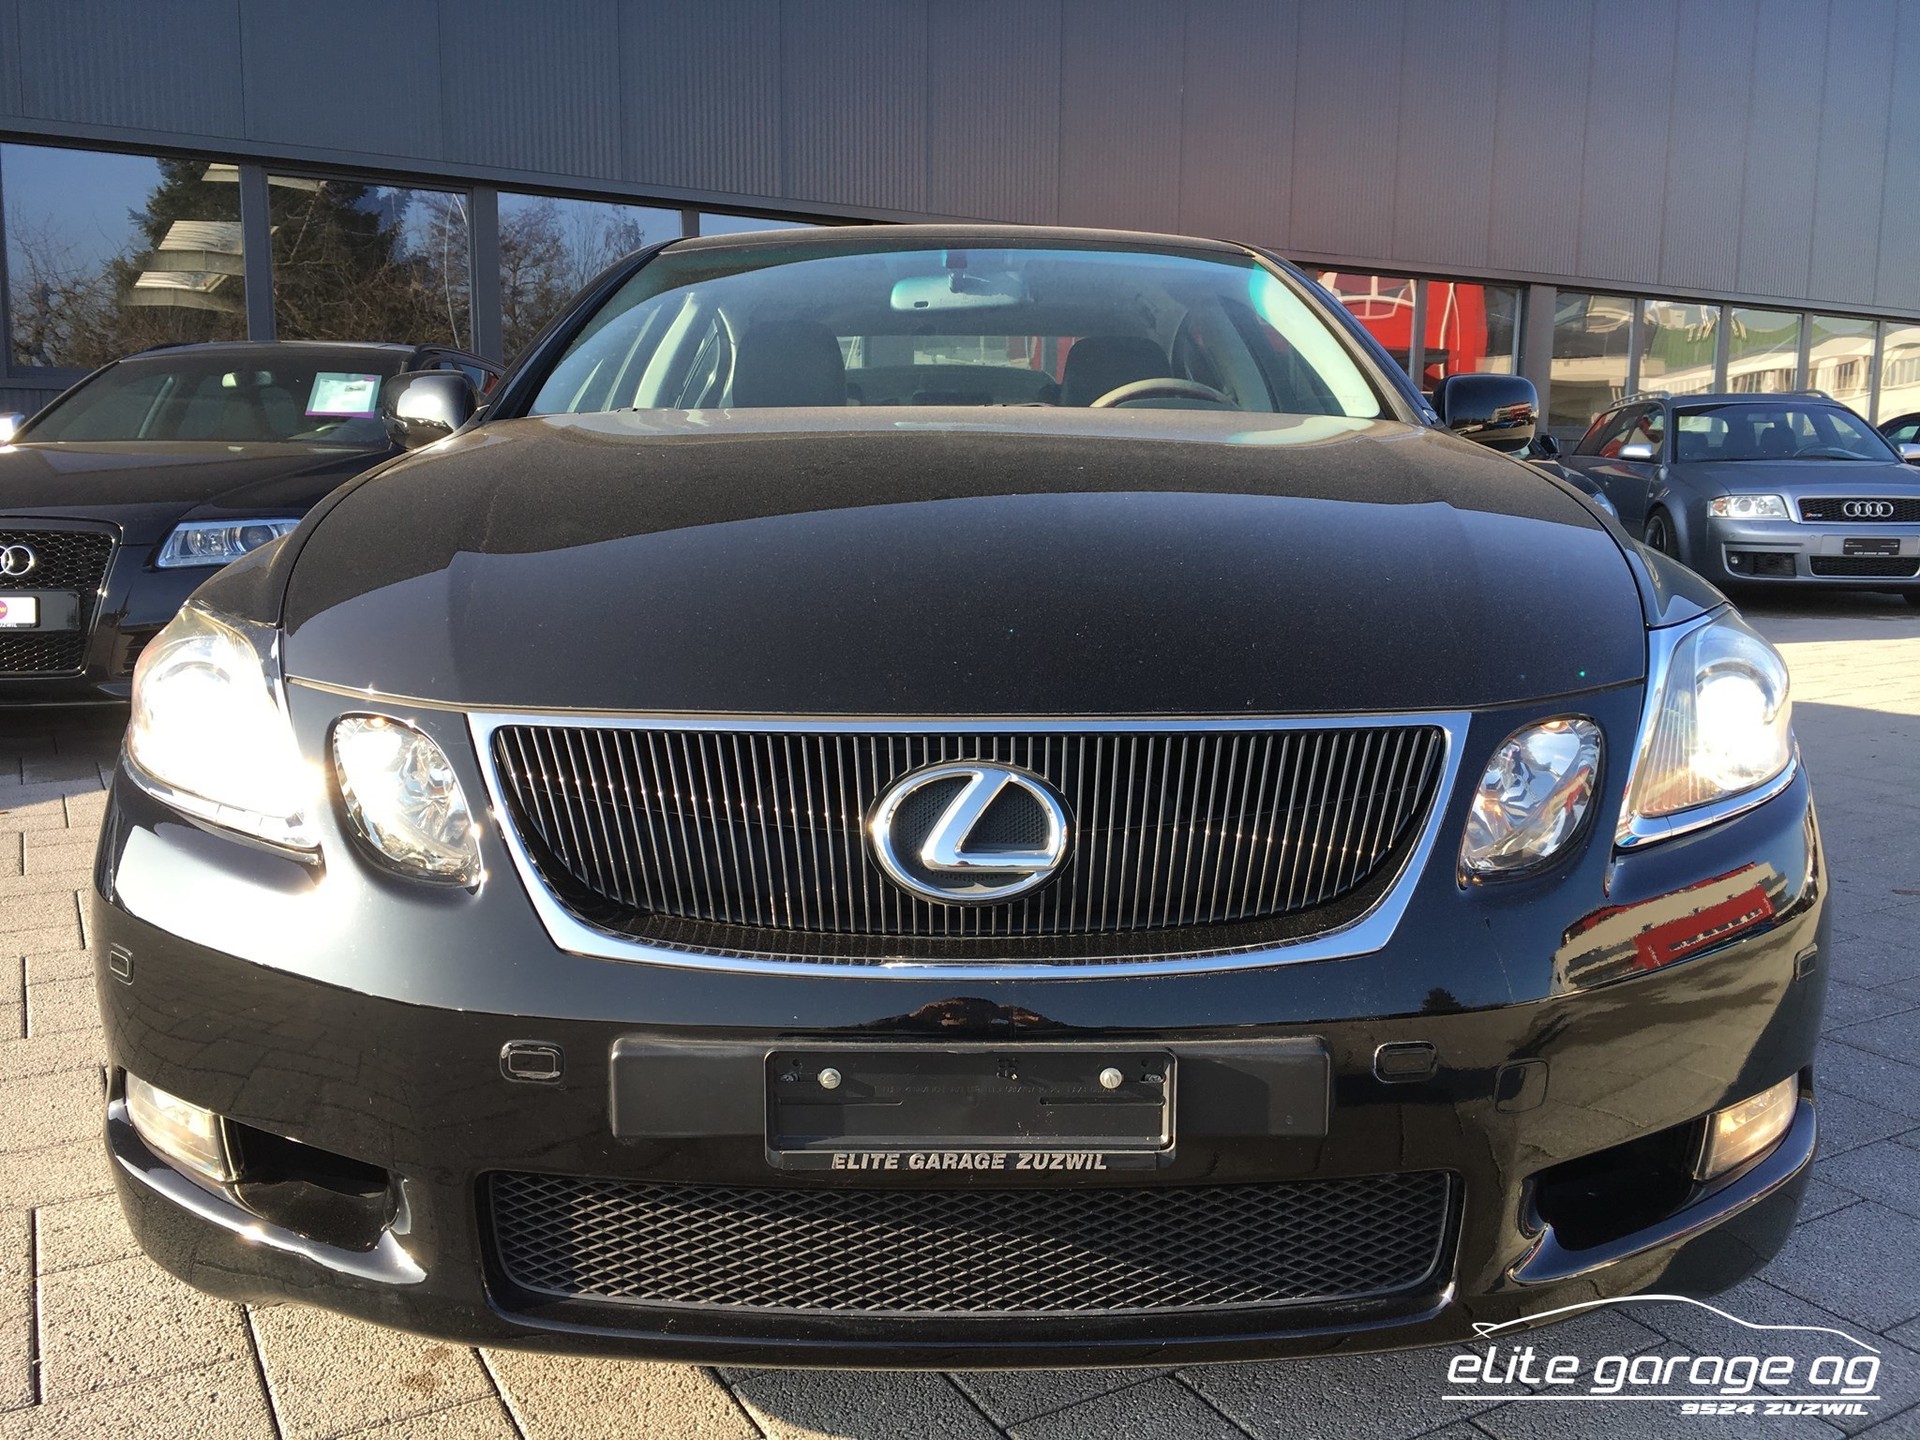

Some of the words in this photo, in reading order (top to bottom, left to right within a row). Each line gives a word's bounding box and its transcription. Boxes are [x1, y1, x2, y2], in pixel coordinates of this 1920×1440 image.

[831, 1153, 901, 1170] ELITE
[908, 1153, 1007, 1170] GARAGE
[1015, 1153, 1108, 1170] ZUZWIL
